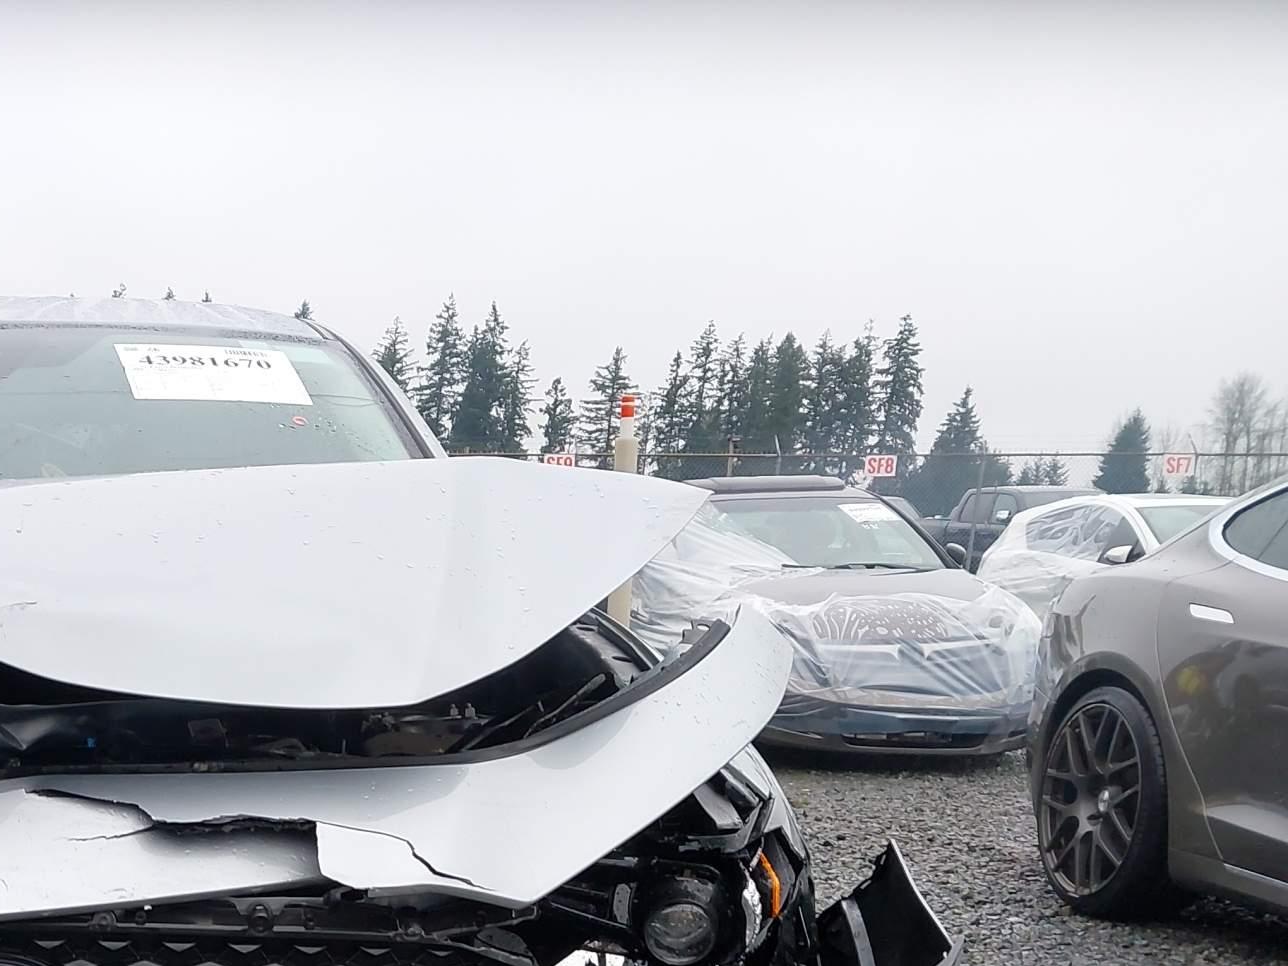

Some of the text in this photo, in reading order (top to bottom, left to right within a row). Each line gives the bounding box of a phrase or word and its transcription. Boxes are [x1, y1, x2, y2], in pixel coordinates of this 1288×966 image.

[138, 354, 272, 370] 43981670
[867, 457, 894, 474] SF8
[1166, 456, 1192, 474] SF7
